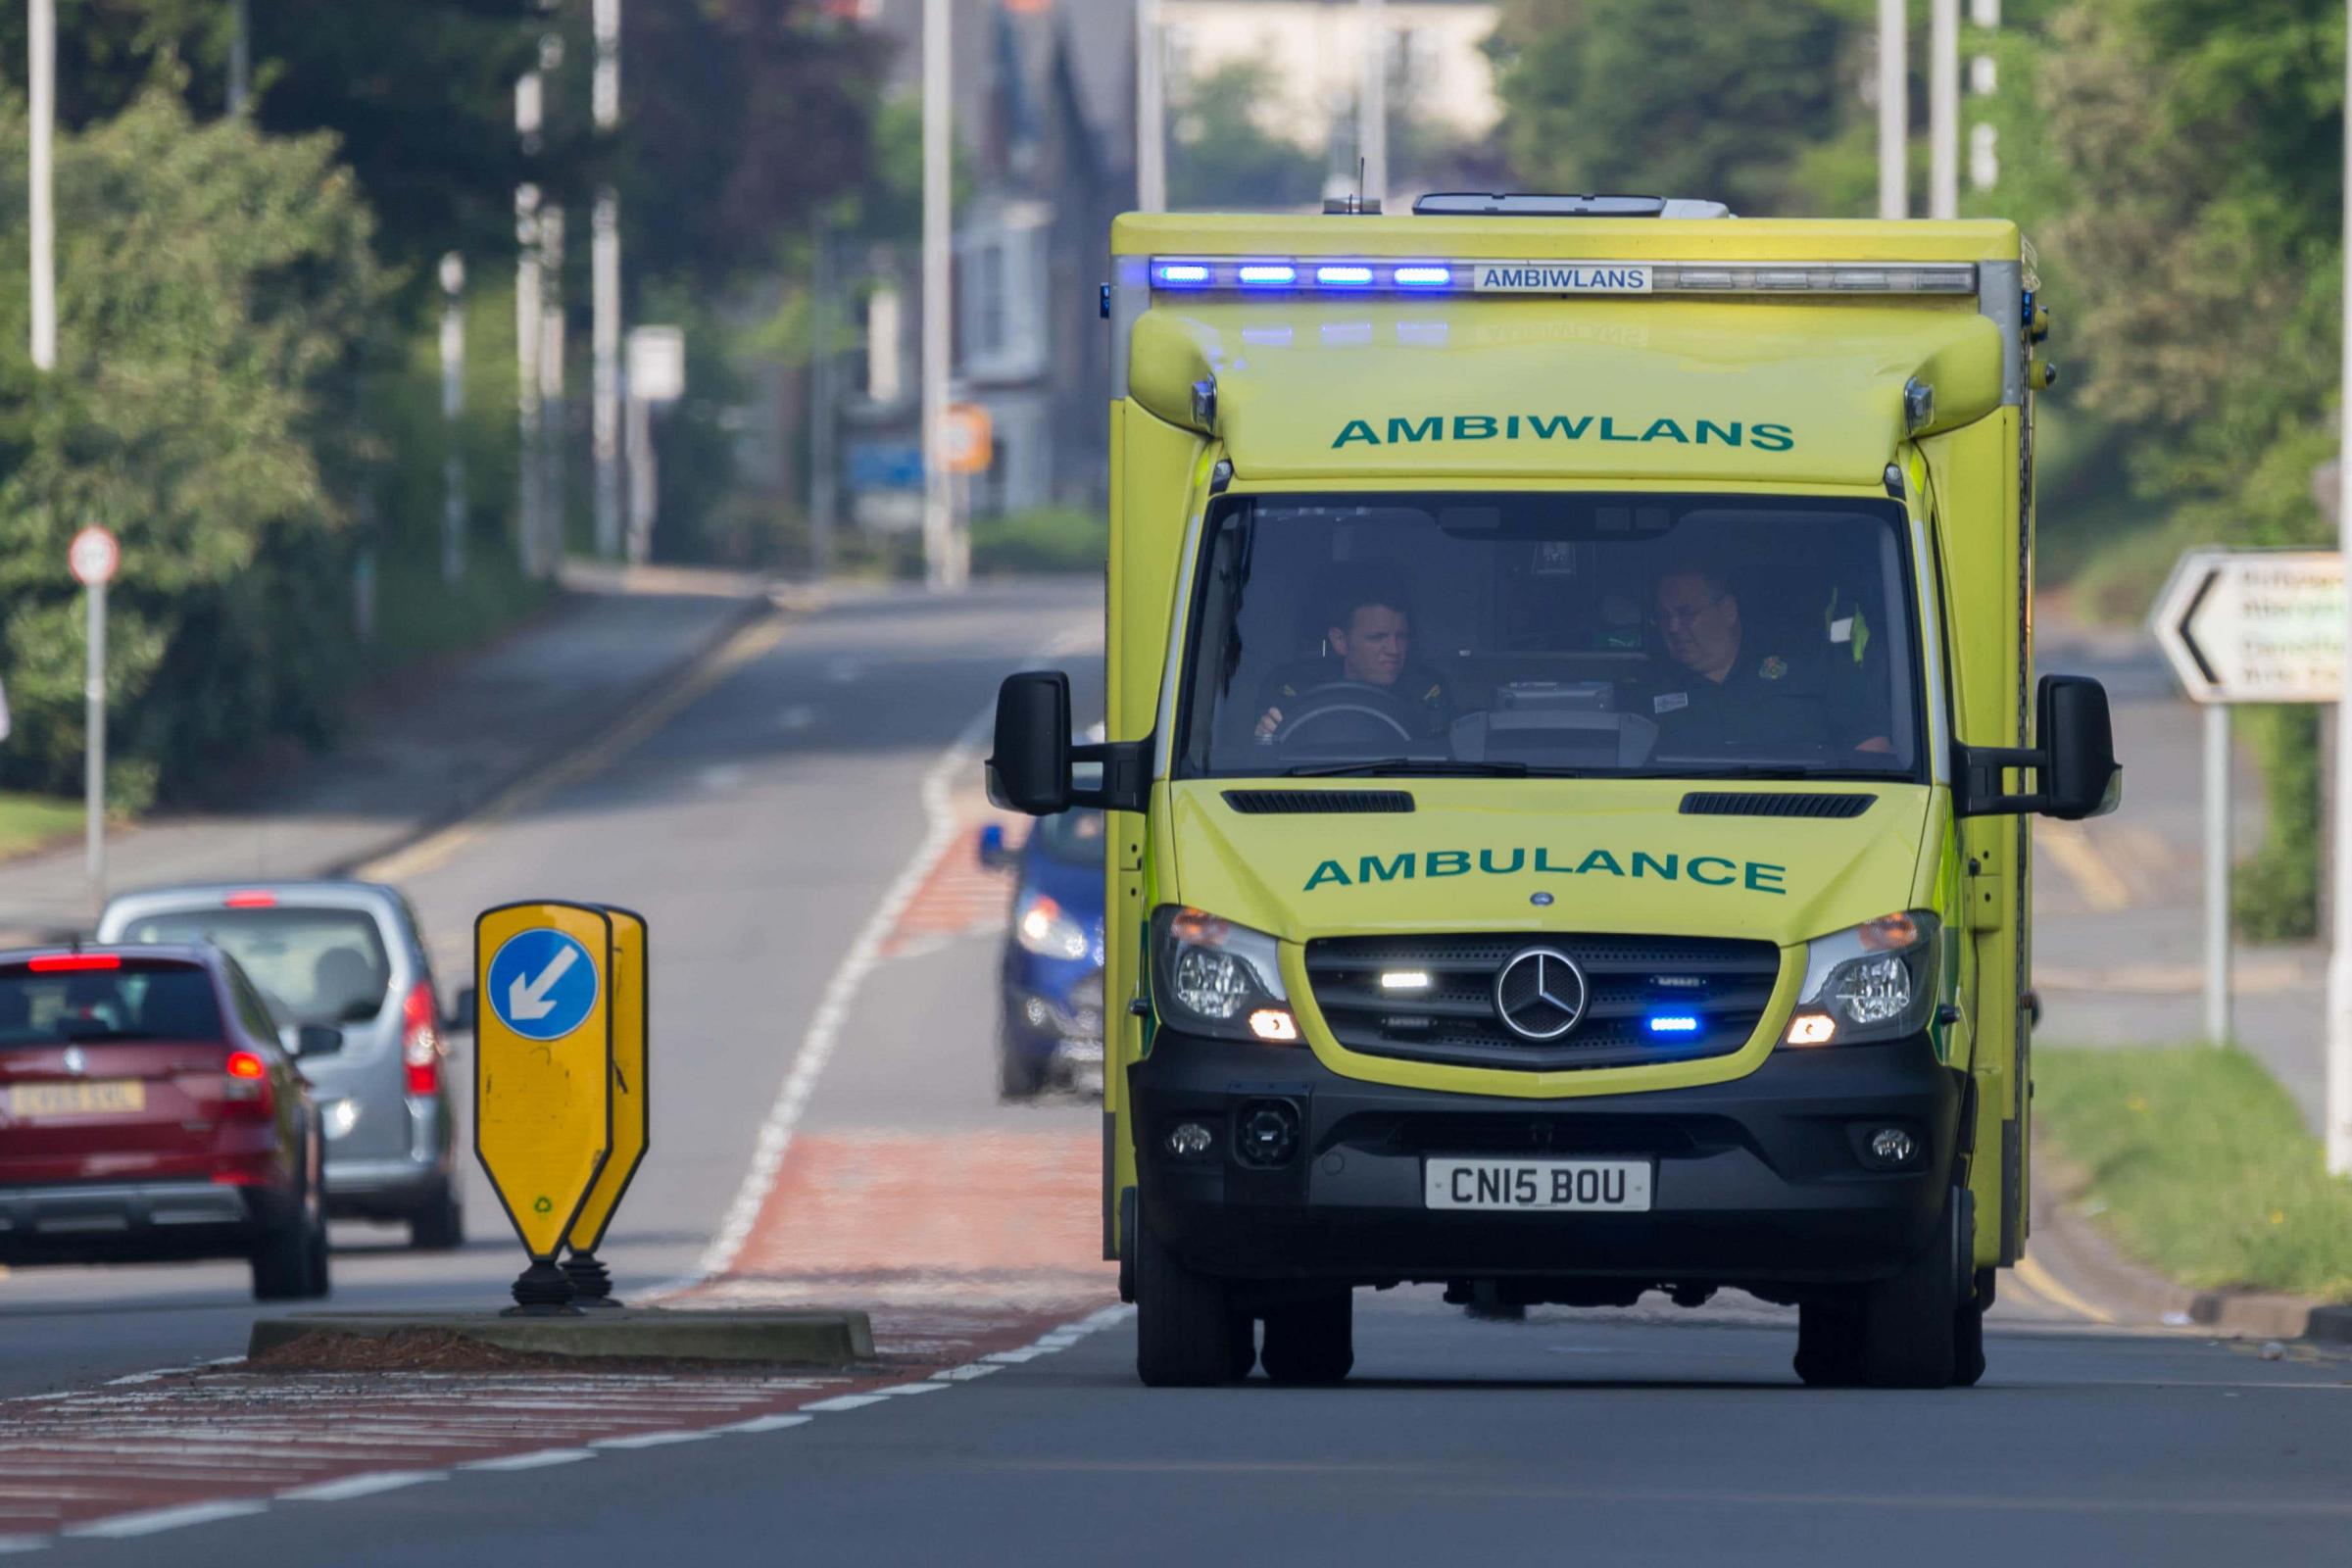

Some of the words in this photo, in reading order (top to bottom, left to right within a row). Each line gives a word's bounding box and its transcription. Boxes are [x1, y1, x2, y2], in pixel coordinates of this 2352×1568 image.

[1484, 270, 1644, 288] AMBIWLANS
[1331, 416, 1794, 452] AMBIWLANS
[1302, 848, 1787, 895] AMBULANCE
[1451, 1167, 1538, 1203] CN15
[1550, 1168, 1626, 1204] BOU
